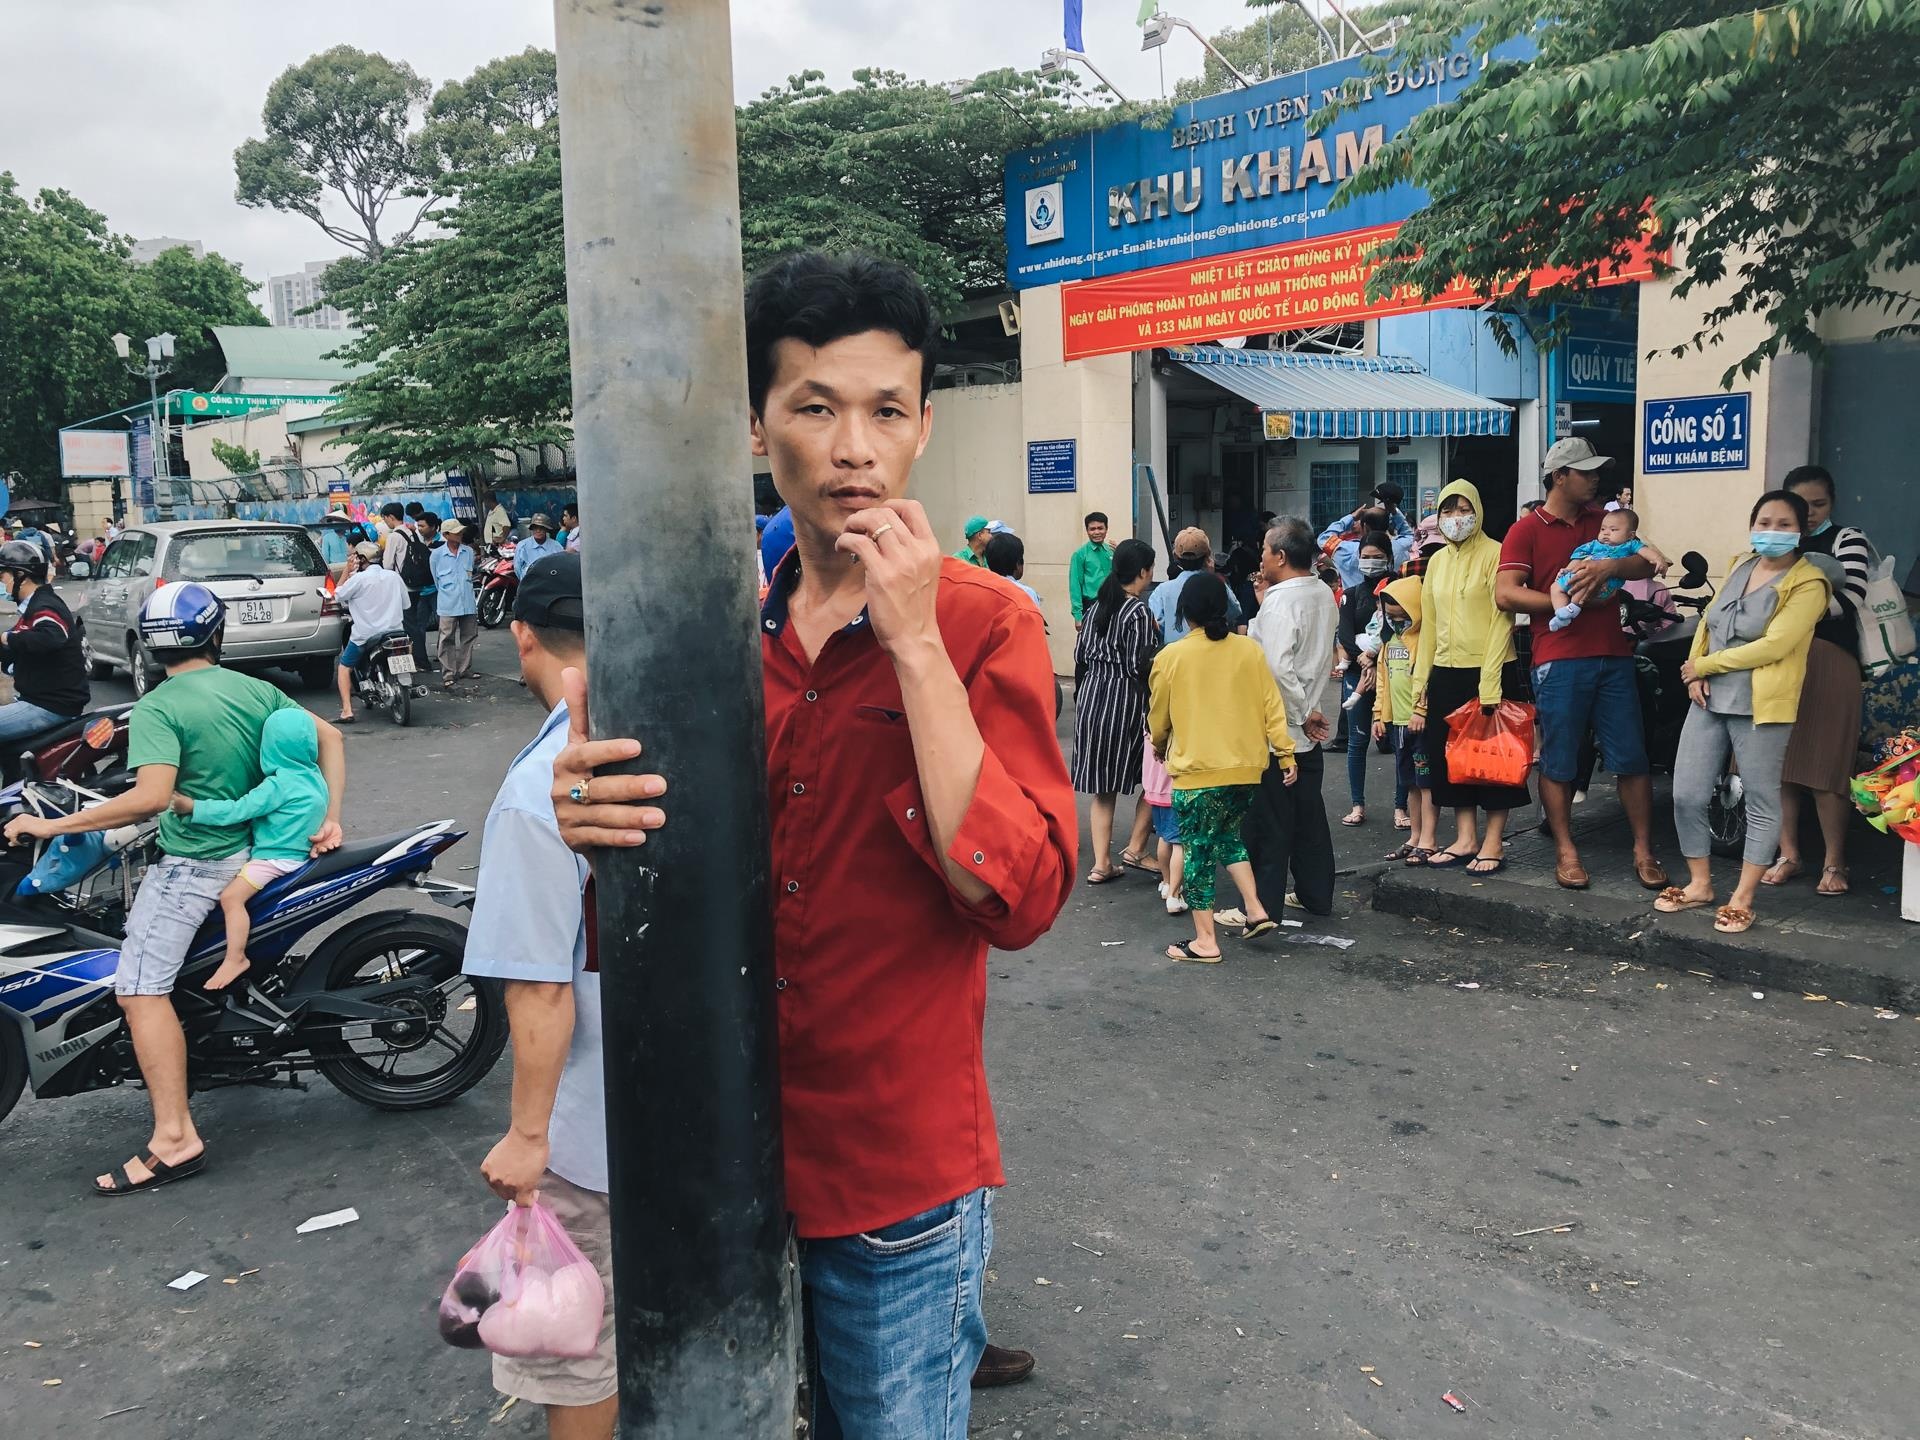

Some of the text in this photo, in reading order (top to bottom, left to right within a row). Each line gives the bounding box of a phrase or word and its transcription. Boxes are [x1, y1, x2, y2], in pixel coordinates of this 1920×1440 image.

[1170, 114, 1236, 150] BỆNH
[1245, 94, 1311, 130] VIỆN
[1107, 166, 1201, 227] KHU
[1190, 266, 1224, 286] NHIỆT
[1227, 262, 1253, 281] LIỆT
[1256, 255, 1290, 274] CHÀO
[1293, 249, 1331, 267] MỪNG
[1334, 239, 1353, 259] KỶ
[1069, 310, 1094, 327] NGÀY
[1096, 304, 1117, 323] GIẢI
[1119, 301, 1154, 319] PHÓNG
[1156, 294, 1185, 313] HOÀN
[1188, 289, 1218, 308] TOÀN
[1221, 281, 1251, 303] MIỀN
[1254, 280, 1281, 297] NAM
[1284, 272, 1327, 292] THỐNG
[1330, 262, 1367, 285] NHẤT
[1138, 320, 1152, 337] VÀ
[1155, 319, 1175, 335] 133
[1178, 314, 1203, 331] NĂM
[1205, 308, 1235, 327] NGÀY
[1239, 301, 1271, 321] QUỐC
[1274, 297, 1291, 317] TẾ
[1294, 298, 1319, 315] LAO
[1322, 291, 1360, 311] ĐỘNG
[1571, 343, 1610, 385] QUẦY
[235, 397, 245, 405] TY
[1650, 403, 1742, 445] CỔNG SỐ 1
[1649, 447, 1743, 466] KHU KHÁM BỆNH
[246, 601, 265, 612] 51A
[273, 885, 349, 920] EXCITER
[35, 1036, 91, 1063] YAMAHA
